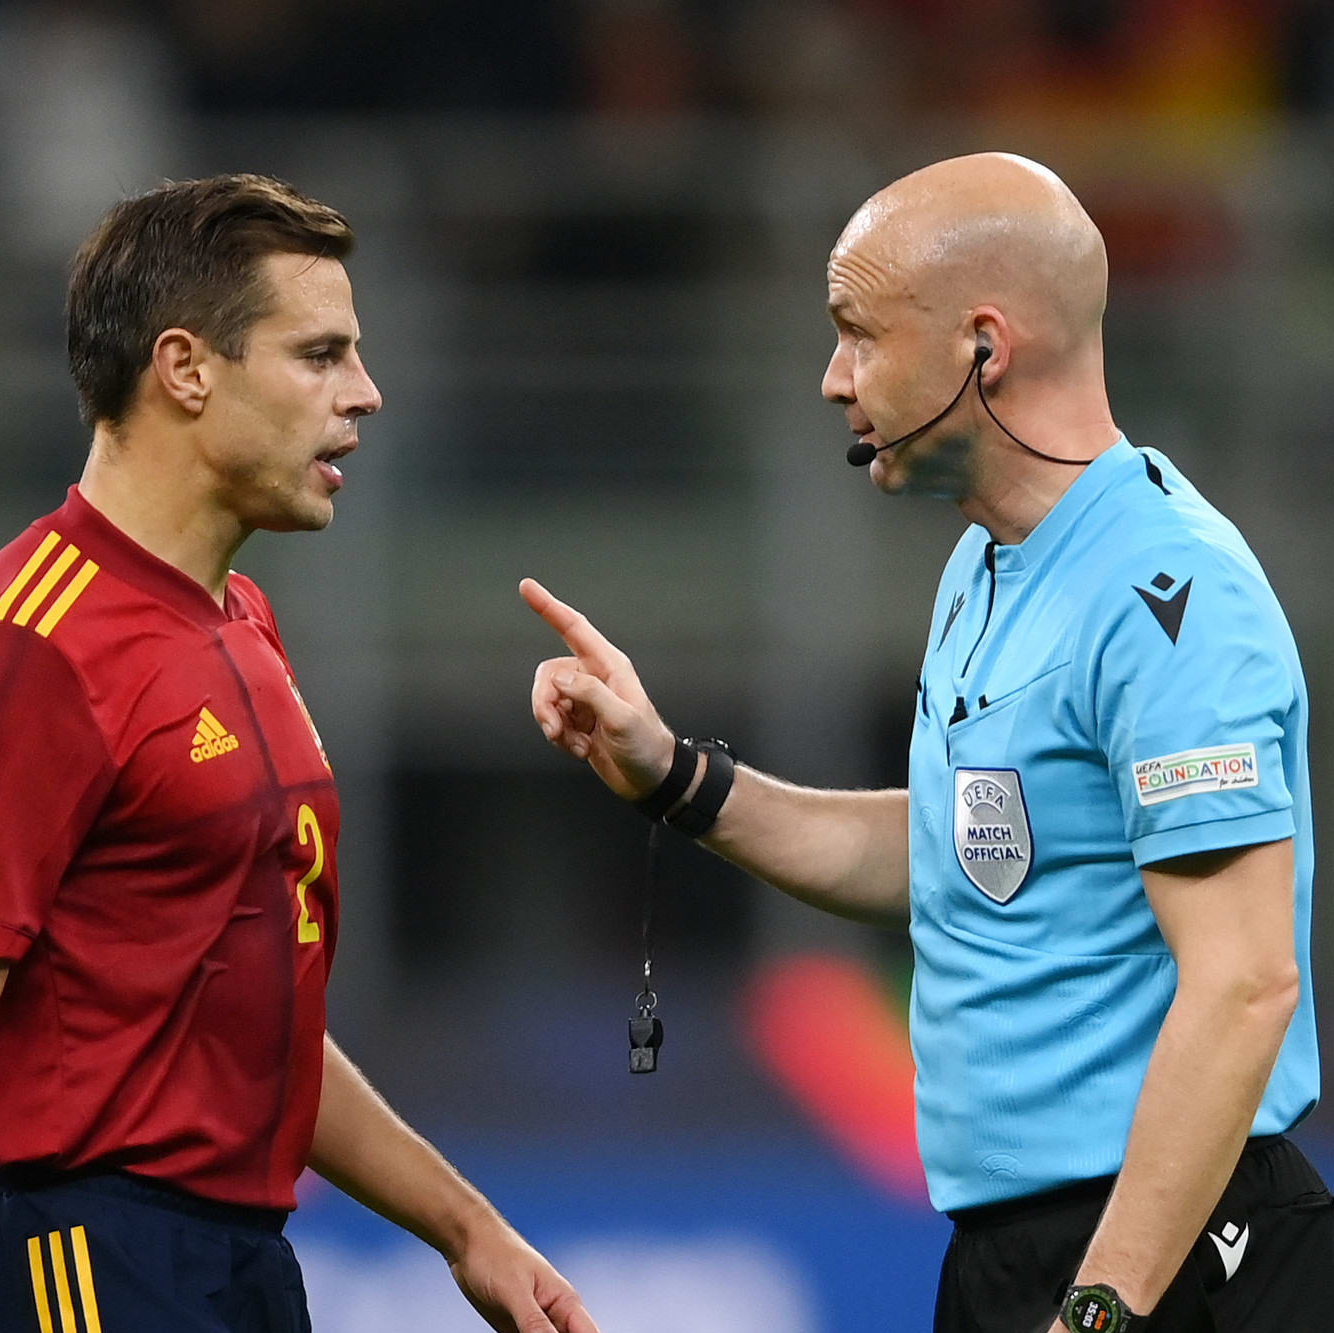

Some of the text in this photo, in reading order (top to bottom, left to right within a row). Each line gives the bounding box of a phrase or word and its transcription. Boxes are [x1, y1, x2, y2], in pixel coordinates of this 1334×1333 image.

[190, 734, 240, 764] adidas
[1136, 761, 1162, 775] UEFA
[1138, 757, 1254, 791] FOUNDATION
[963, 785, 1005, 809] UEFA
[967, 826, 1013, 841] MATCH
[963, 845, 1024, 861] OFFICIAL
[297, 804, 324, 943] 2
